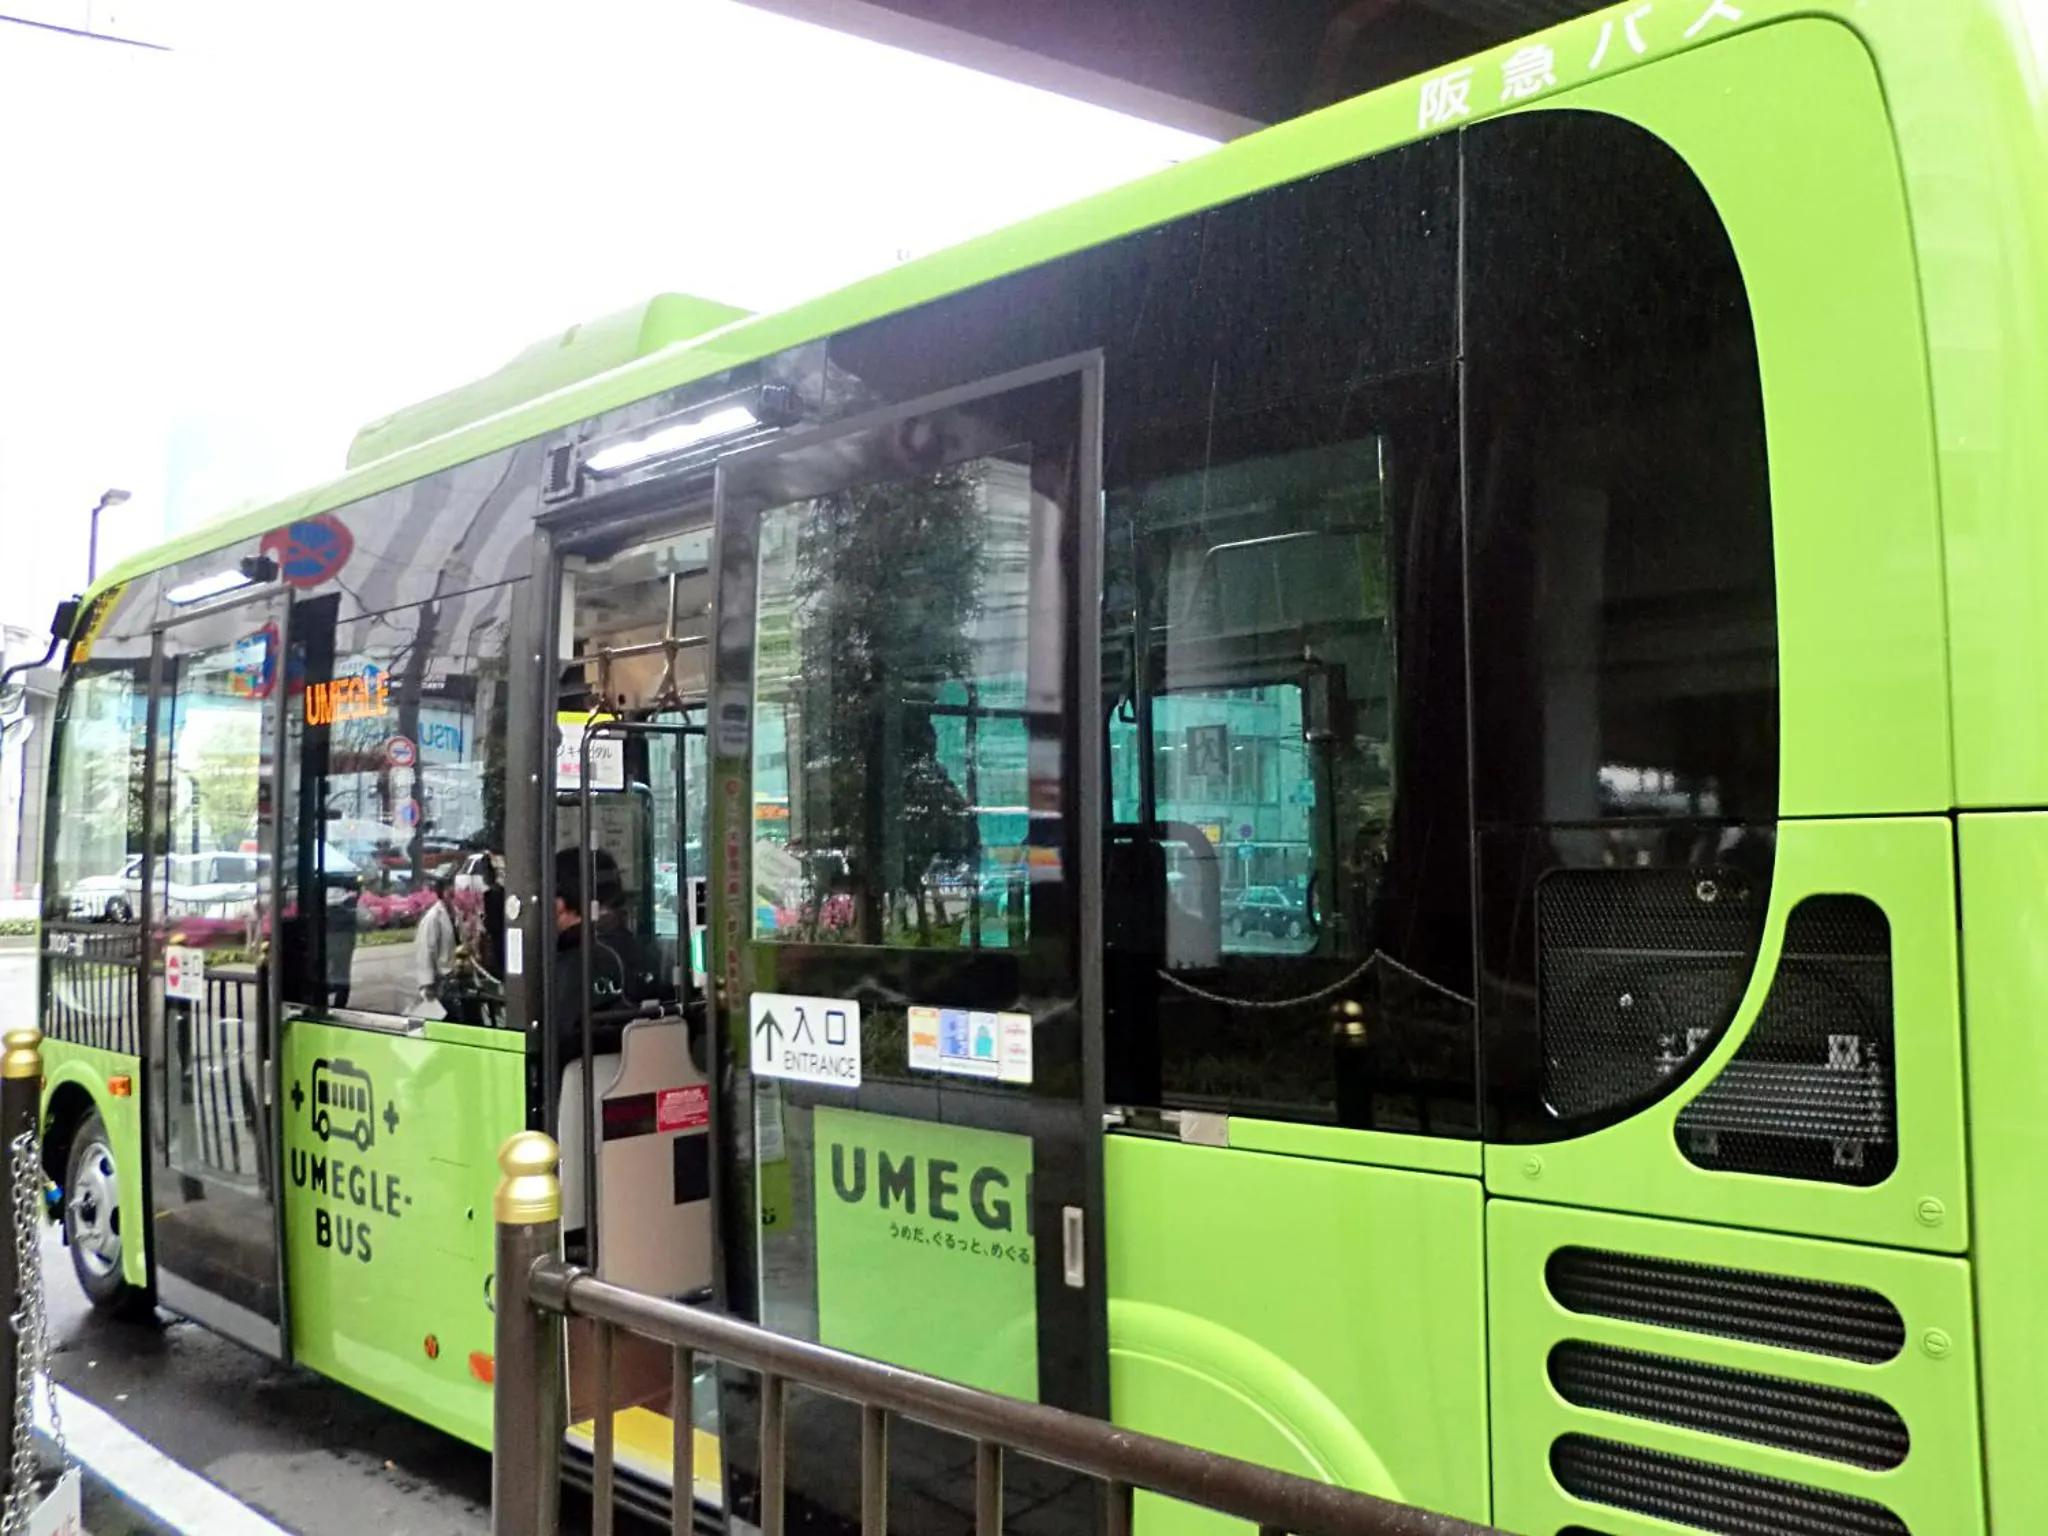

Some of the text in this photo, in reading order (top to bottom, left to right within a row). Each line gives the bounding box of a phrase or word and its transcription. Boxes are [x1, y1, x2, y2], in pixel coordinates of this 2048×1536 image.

[1418, 0, 1743, 129] 阪急バス
[306, 670, 390, 726] UMEGLE
[792, 1006, 846, 1045] 入口
[784, 1050, 856, 1079] ENTRANCE
[316, 1207, 372, 1263] BUS
